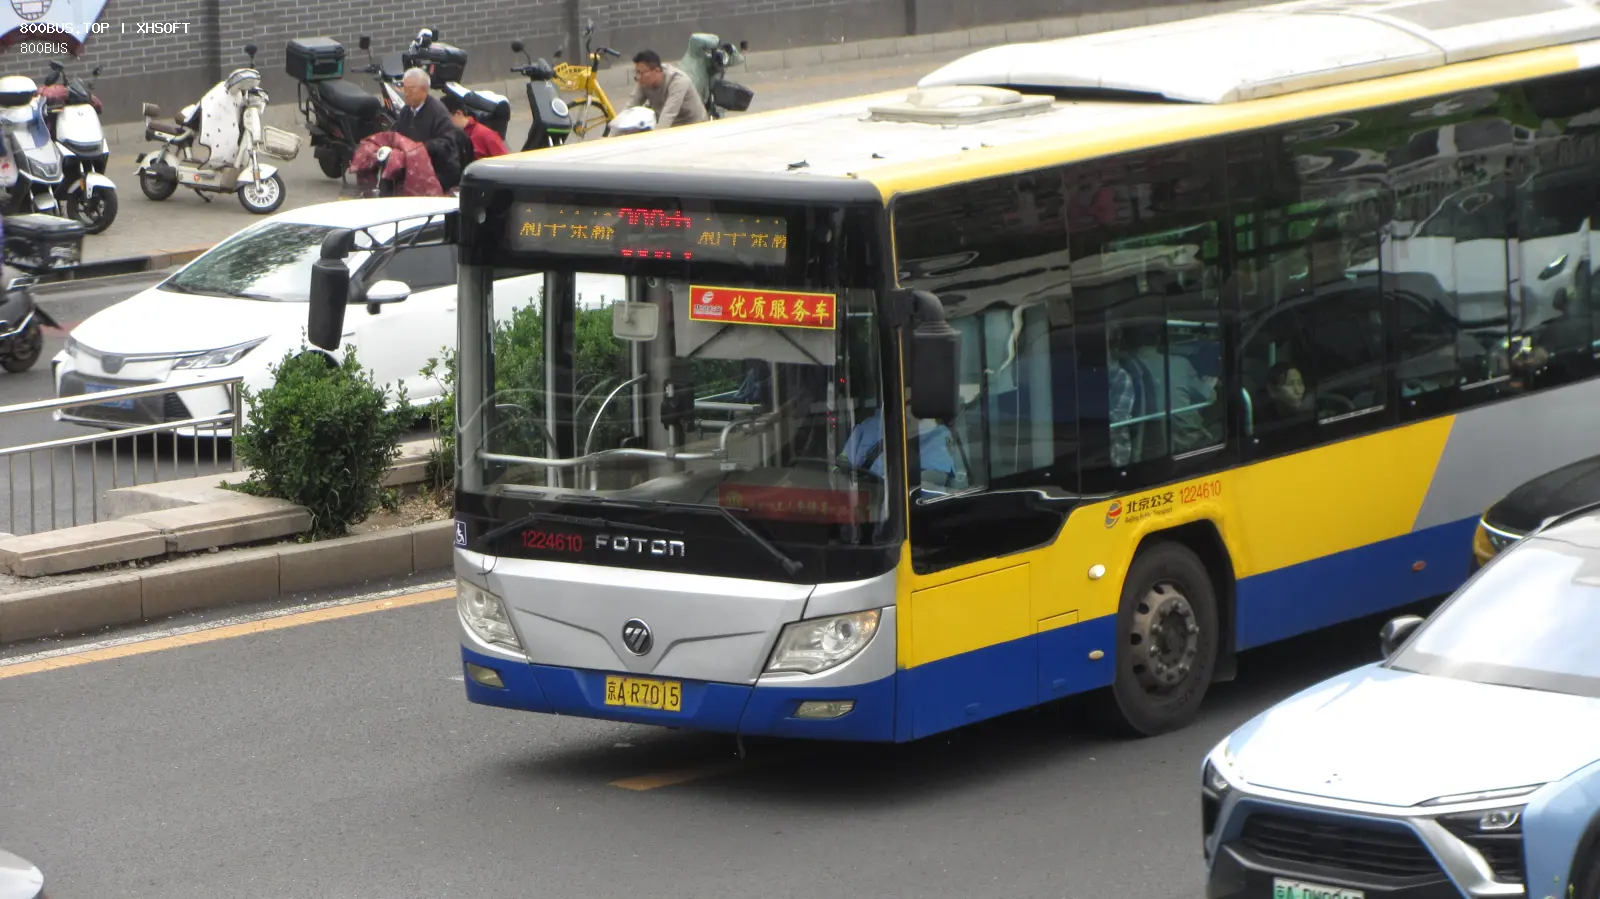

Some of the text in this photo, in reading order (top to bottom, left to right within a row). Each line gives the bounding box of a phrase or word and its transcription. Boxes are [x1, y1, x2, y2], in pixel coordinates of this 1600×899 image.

[729, 295, 830, 324] 优质服务车
[1126, 480, 1222, 513] 北京公交 1224610
[521, 530, 583, 552] 1224610
